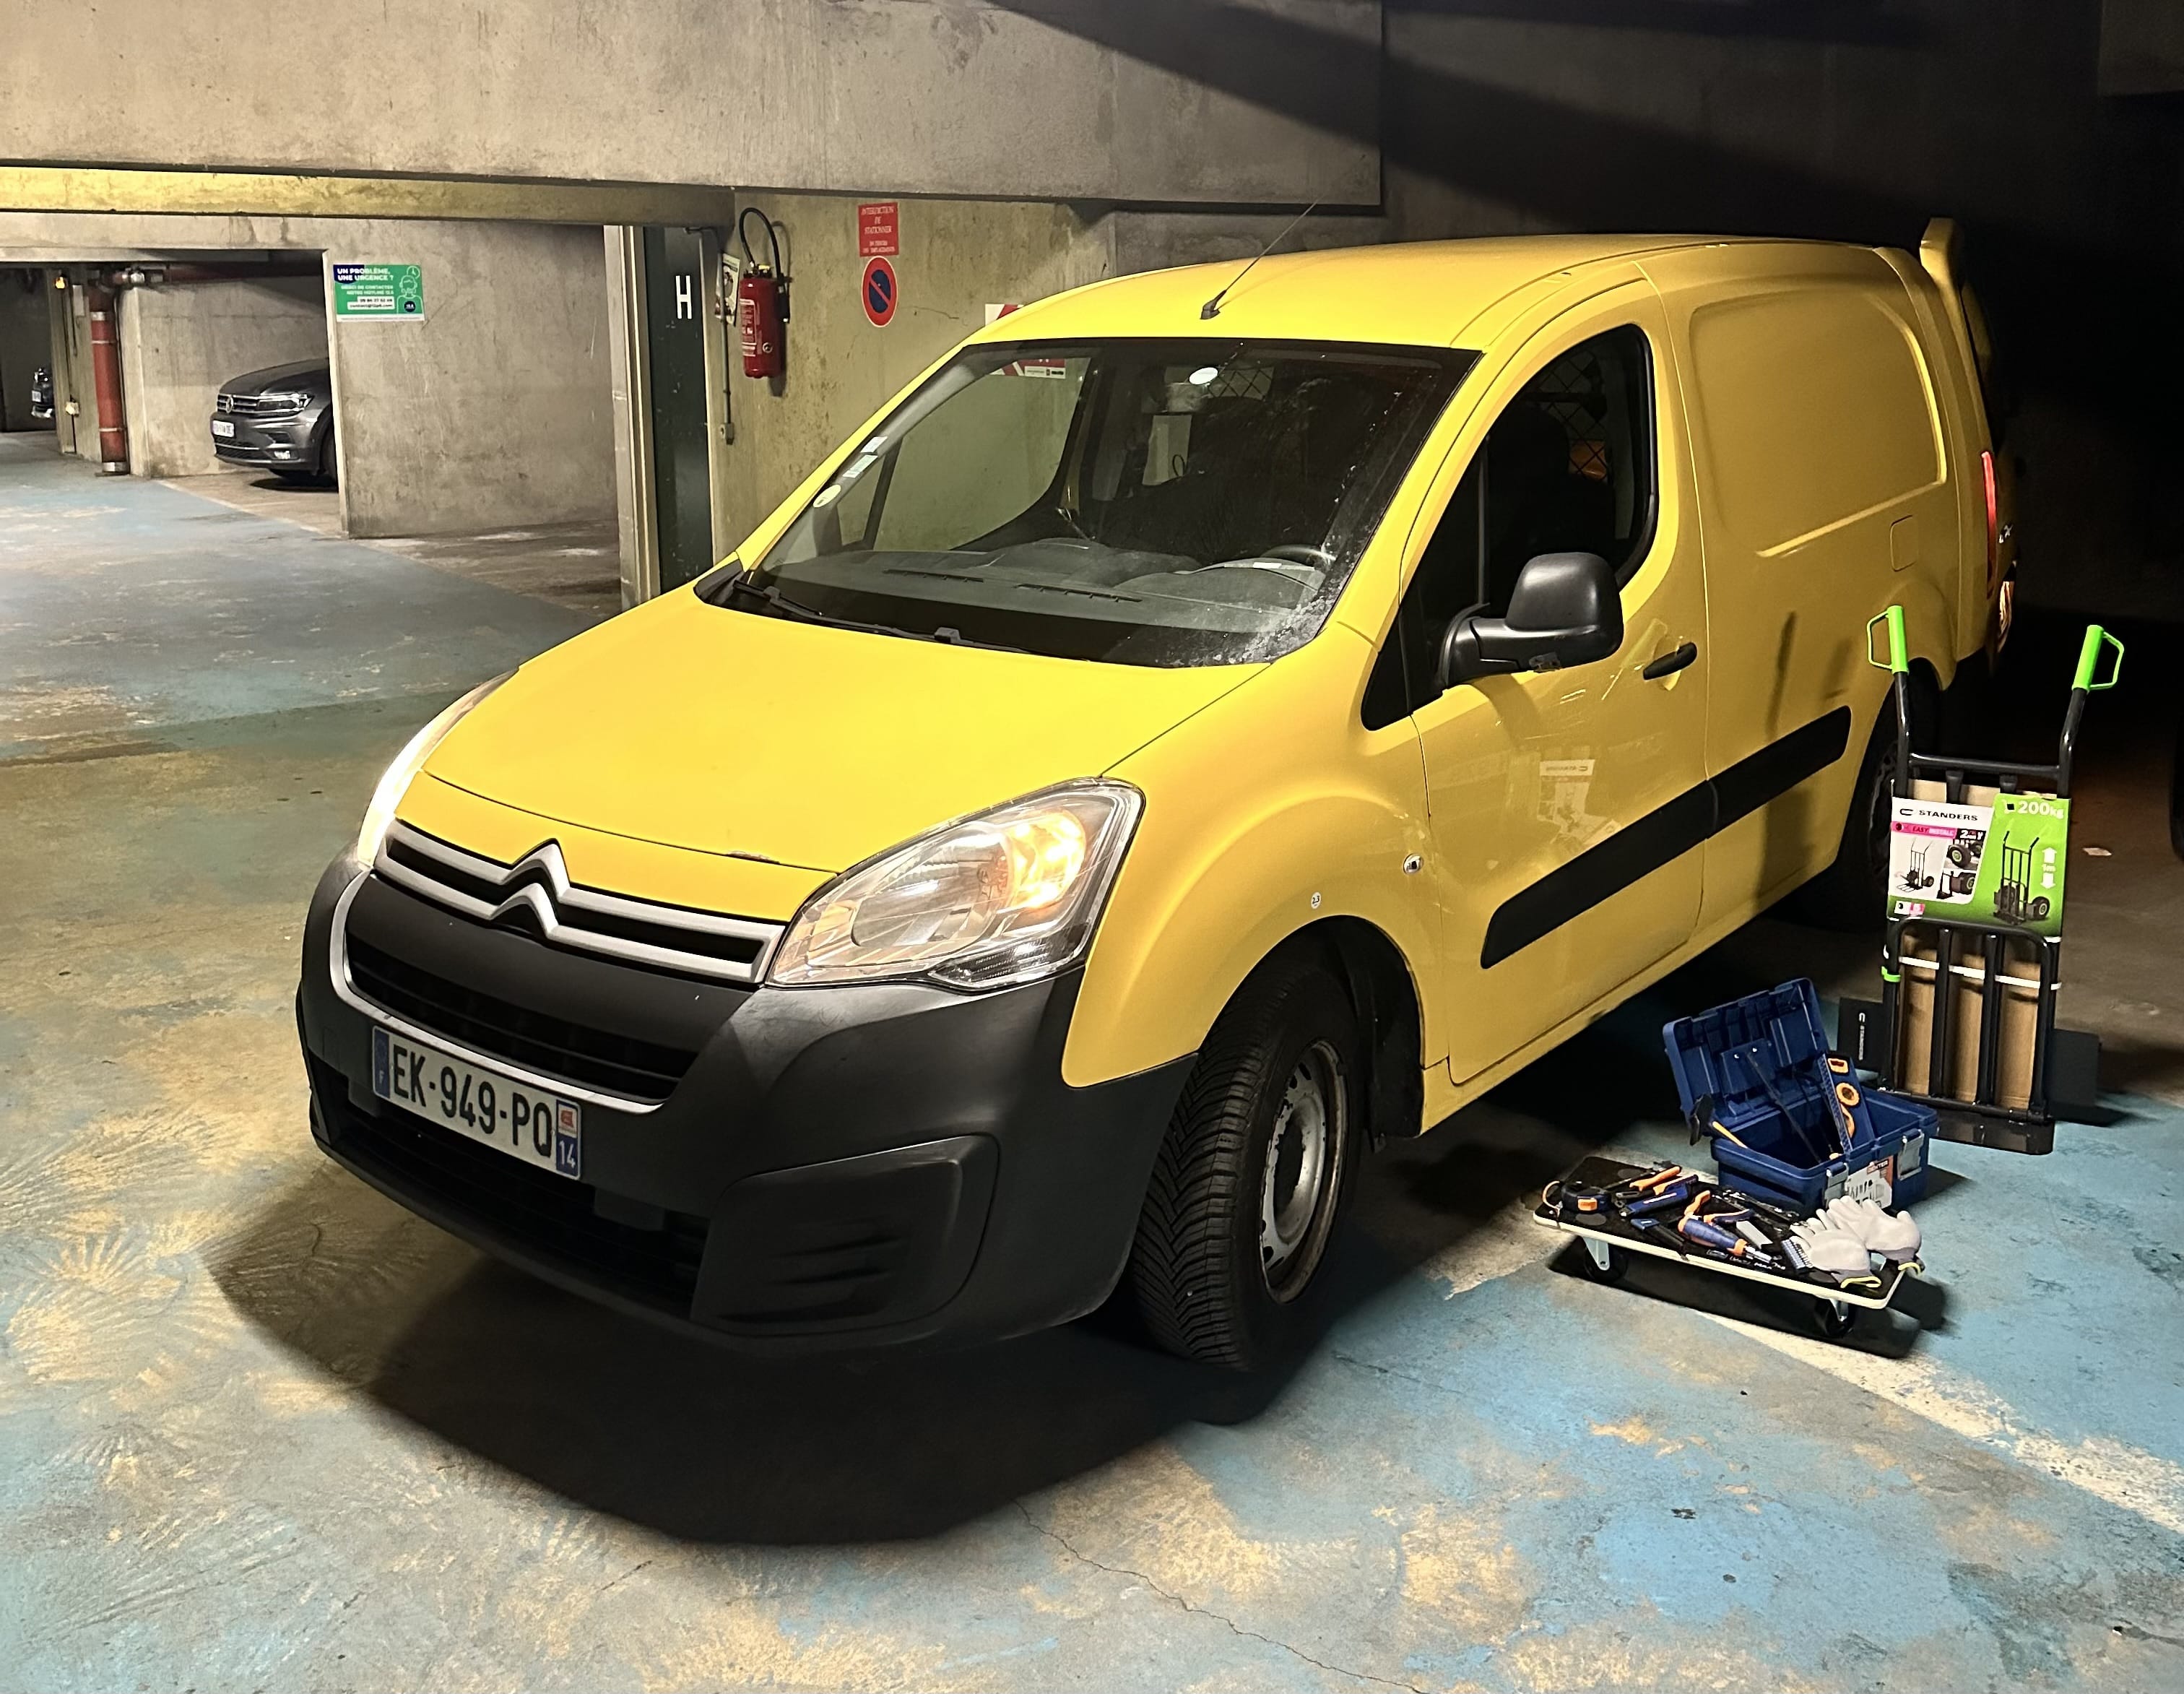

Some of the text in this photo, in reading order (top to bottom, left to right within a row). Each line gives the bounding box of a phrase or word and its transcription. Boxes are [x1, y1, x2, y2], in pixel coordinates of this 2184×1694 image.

[875, 216, 881, 225] DE
[675, 275, 692, 319] H
[1919, 810, 1978, 821] STANDERS
[378, 1069, 384, 1084] F
[559, 1140, 576, 1167] 14
